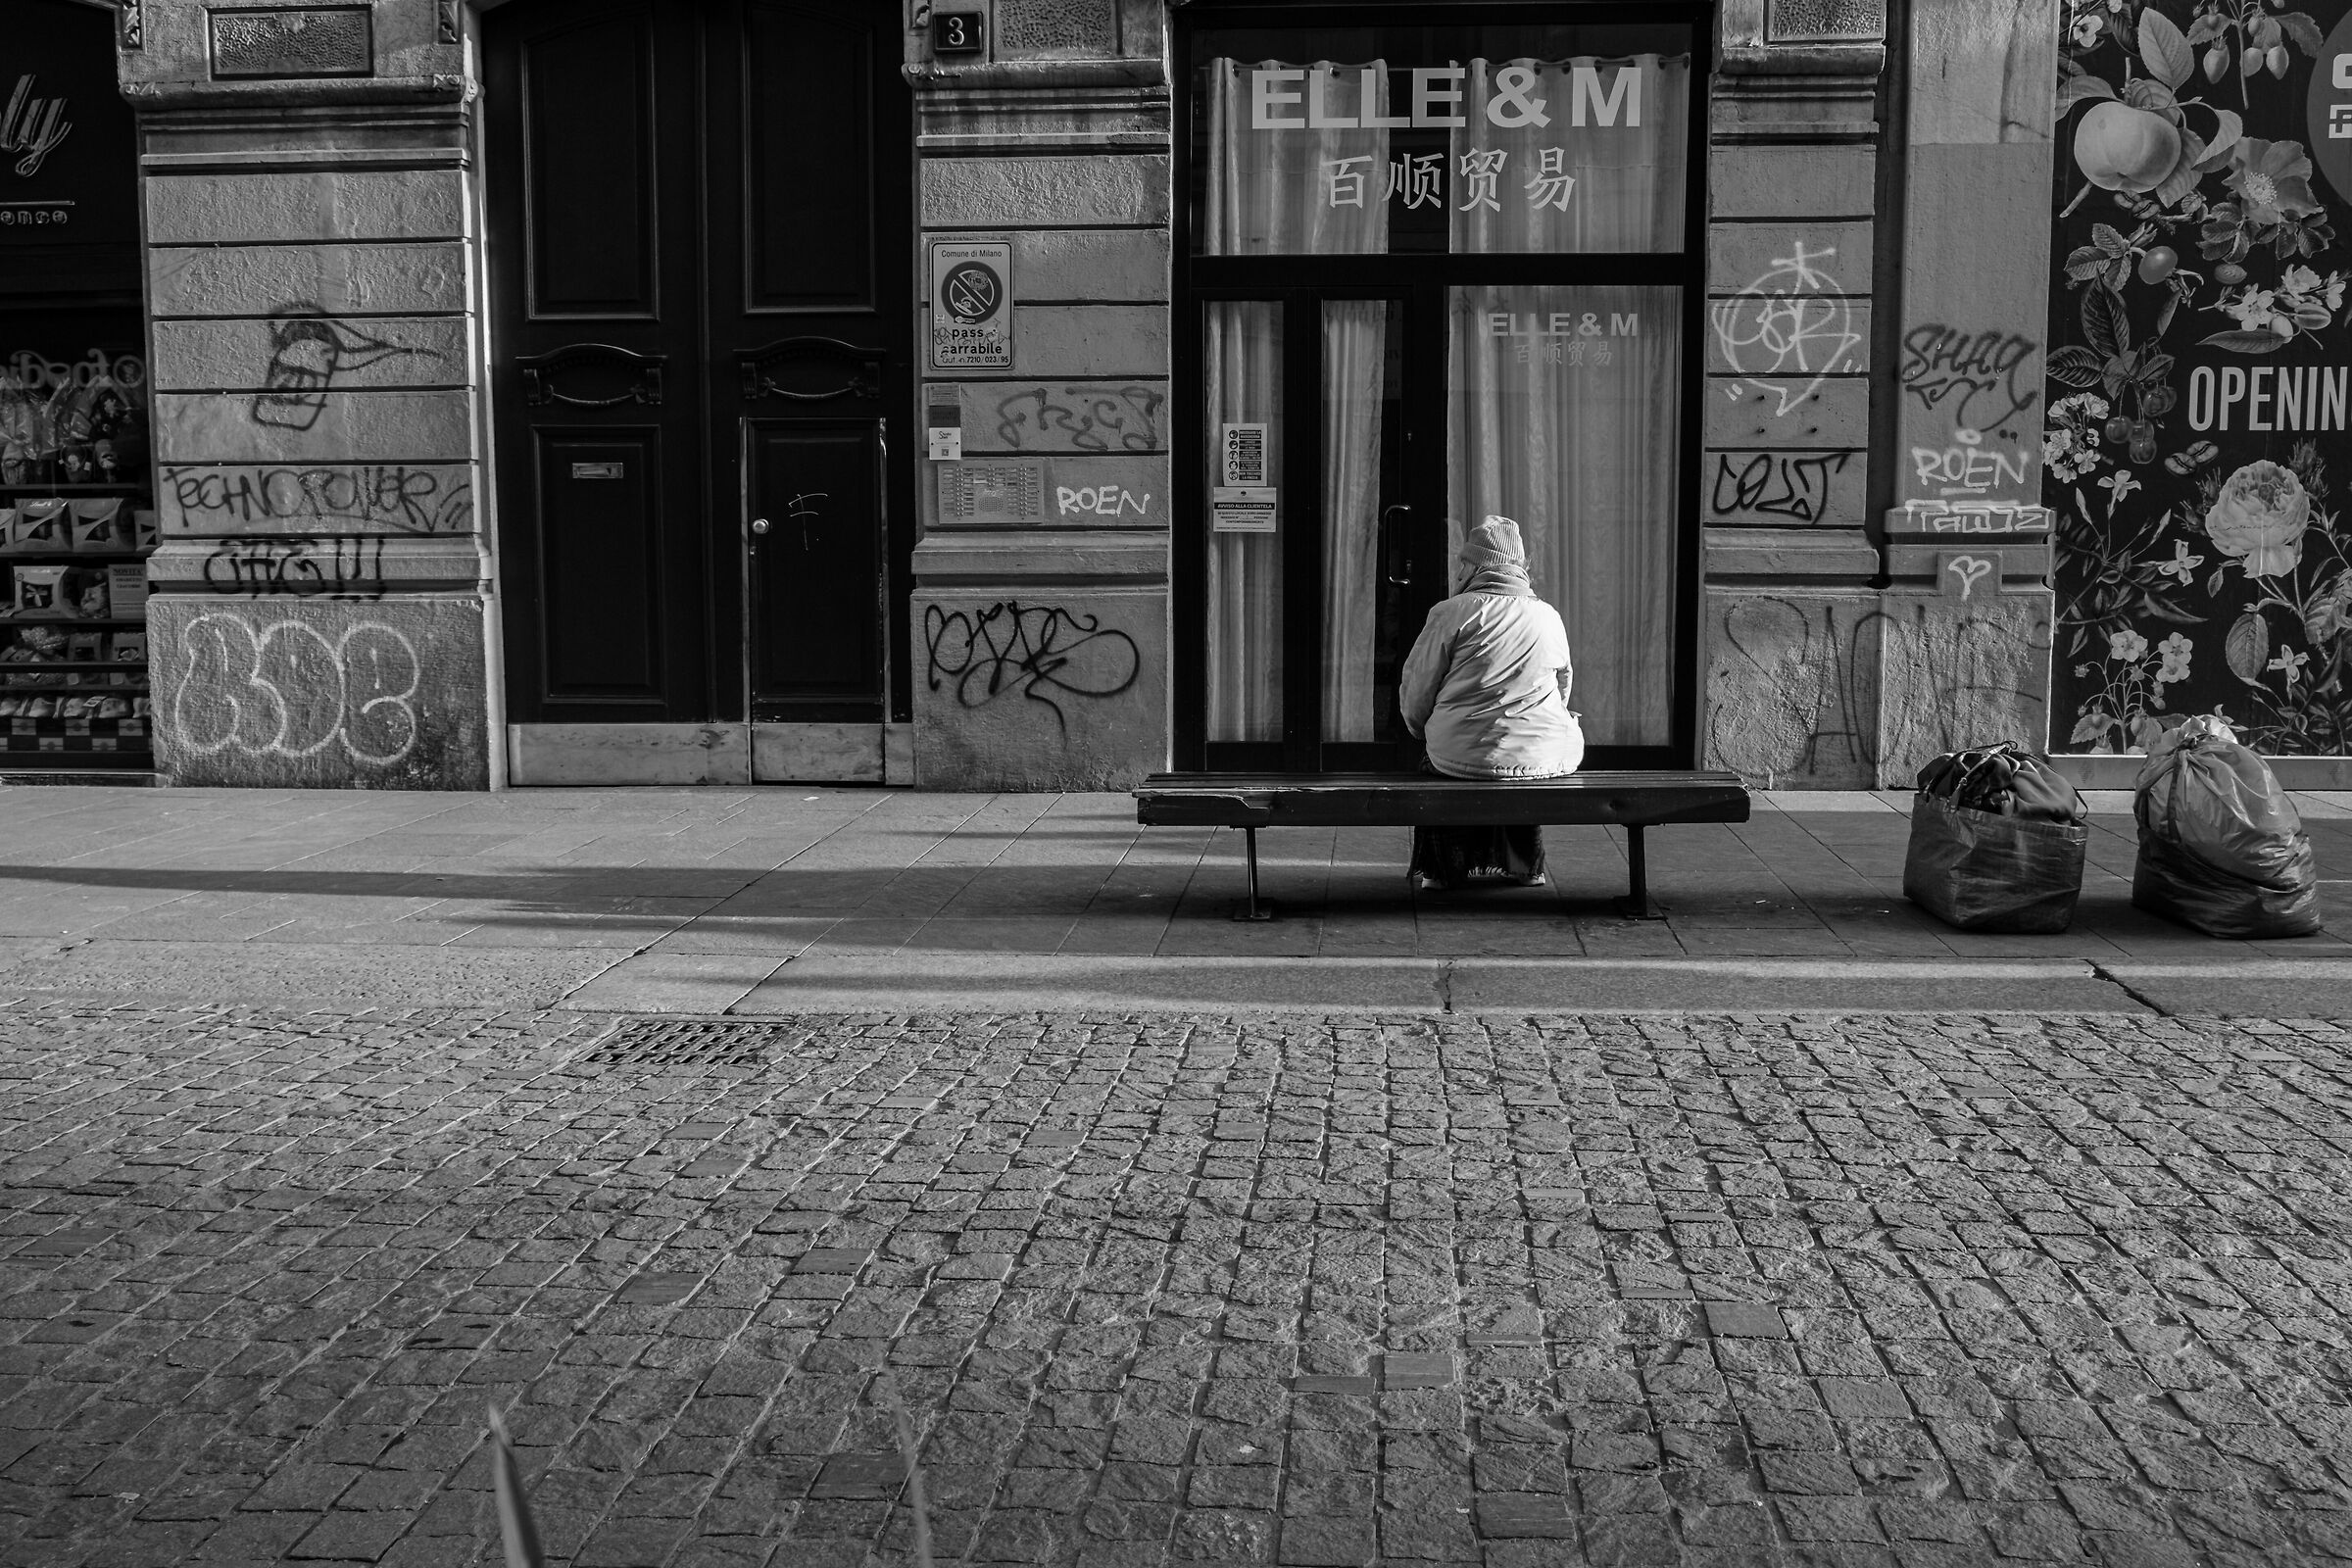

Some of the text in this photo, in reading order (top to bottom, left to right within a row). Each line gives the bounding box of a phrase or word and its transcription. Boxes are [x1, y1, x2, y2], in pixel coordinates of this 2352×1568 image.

[948, 17, 965, 48] 3
[1251, 66, 1642, 129] ELLE & M
[0, 74, 73, 177] ly
[1321, 146, 1577, 213] 百顺贸易
[952, 328, 985, 339] pass
[1488, 313, 1638, 336] ELLE & M
[1514, 341, 1613, 368] 百顺贸易
[2188, 366, 2352, 431] OPENIN
[1912, 446, 2030, 486] ROEN
[1056, 485, 1152, 517] ROEN
